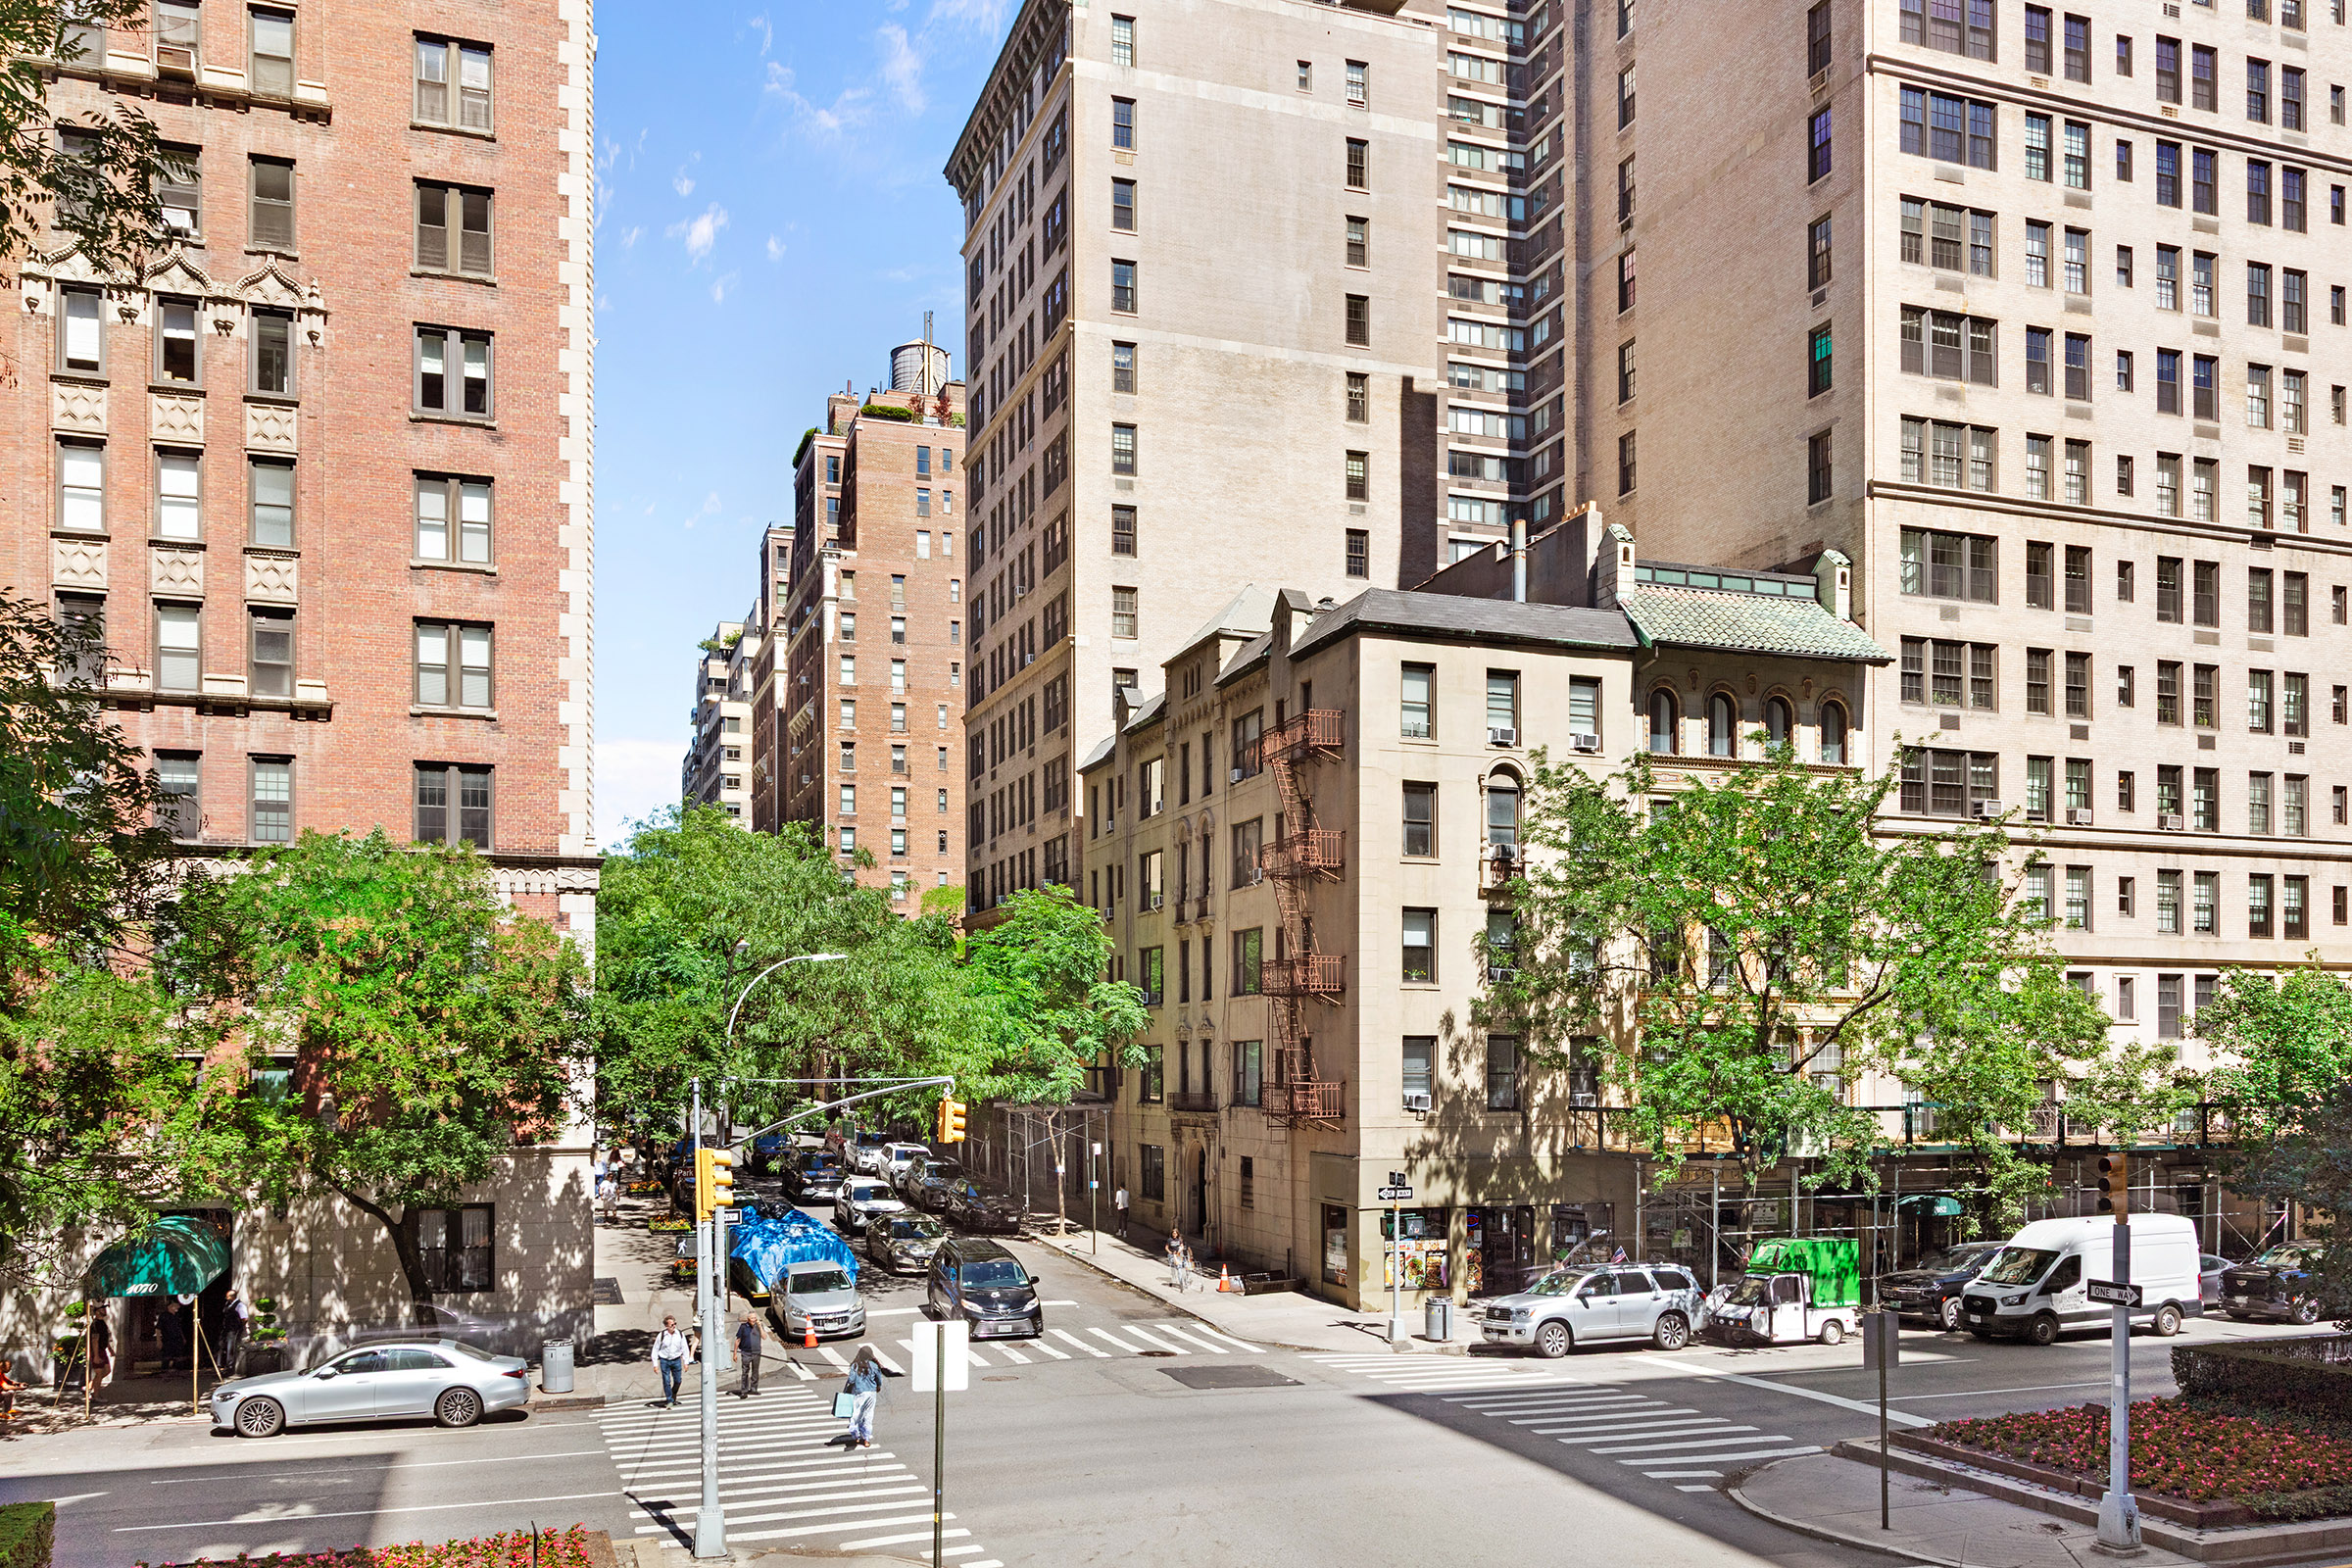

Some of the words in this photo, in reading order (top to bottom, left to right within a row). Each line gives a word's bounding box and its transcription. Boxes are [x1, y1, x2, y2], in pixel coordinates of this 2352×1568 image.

[126, 1283, 159, 1295] 1070
[2094, 1286, 2111, 1298] ONE
[2117, 1288, 2134, 1300] WAY
